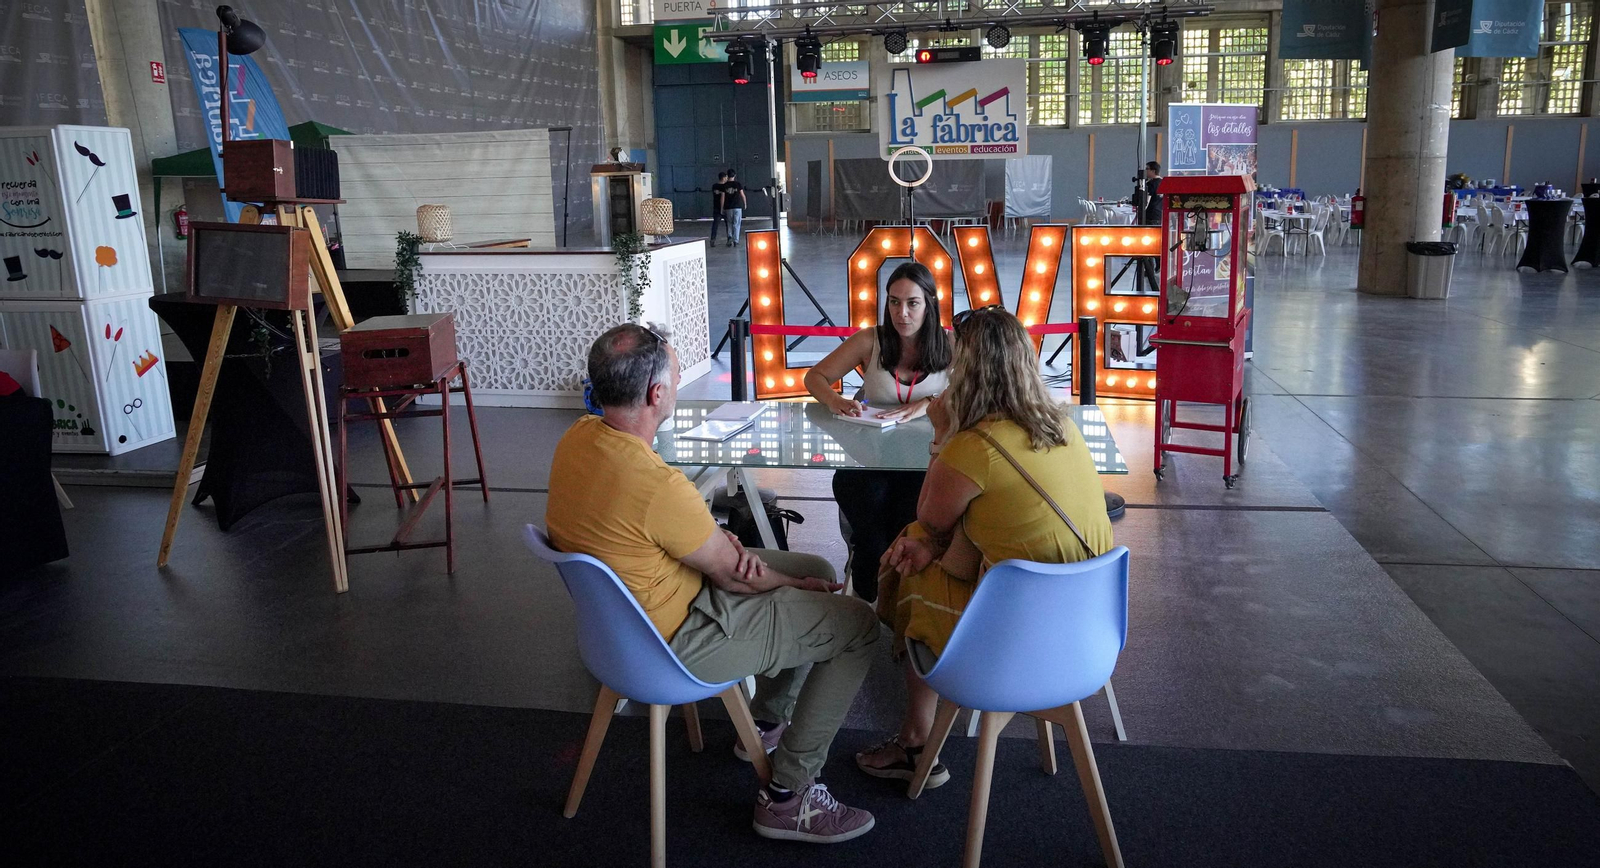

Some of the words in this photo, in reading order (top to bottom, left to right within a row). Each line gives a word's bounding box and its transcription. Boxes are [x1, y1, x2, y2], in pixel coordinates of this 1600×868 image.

[663, 1, 703, 12] PUERTA
[823, 70, 858, 81] ASEOS
[36, 92, 69, 103] IFECA
[886, 93, 918, 144] La
[931, 112, 1020, 144] fábrica
[1208, 121, 1221, 137] los
[1221, 122, 1253, 137] detalles
[936, 145, 968, 154] eventos
[973, 144, 1015, 153] educación
[1, 179, 37, 190] recuerda
